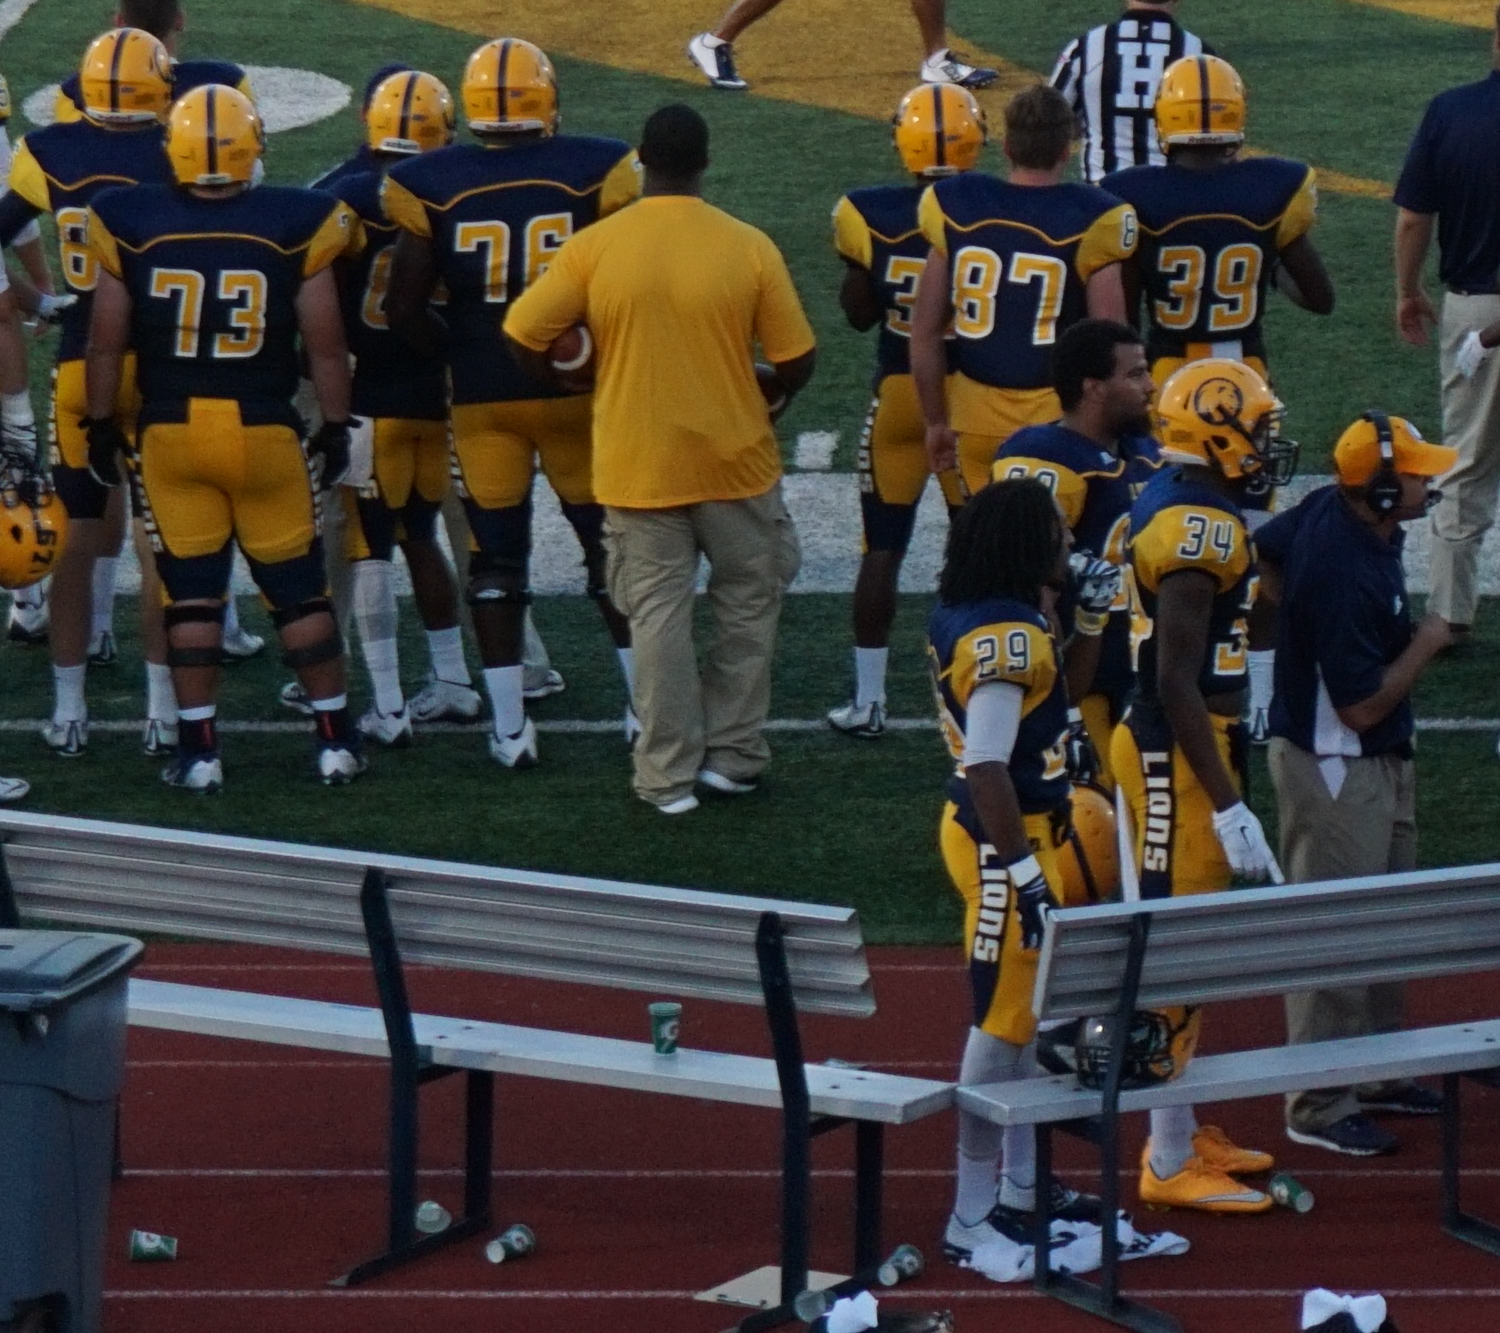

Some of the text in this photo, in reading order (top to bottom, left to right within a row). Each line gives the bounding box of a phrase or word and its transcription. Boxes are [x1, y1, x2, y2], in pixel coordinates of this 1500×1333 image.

[1115, 41, 1166, 109] H
[454, 210, 575, 304] 76
[952, 245, 1068, 346] 87
[1155, 242, 1263, 332] 39
[150, 267, 268, 360] 73
[1178, 514, 1236, 564] 34
[974, 629, 1029, 681] 29
[1144, 749, 1170, 874] LIONS
[972, 842, 1011, 964] LIONS
